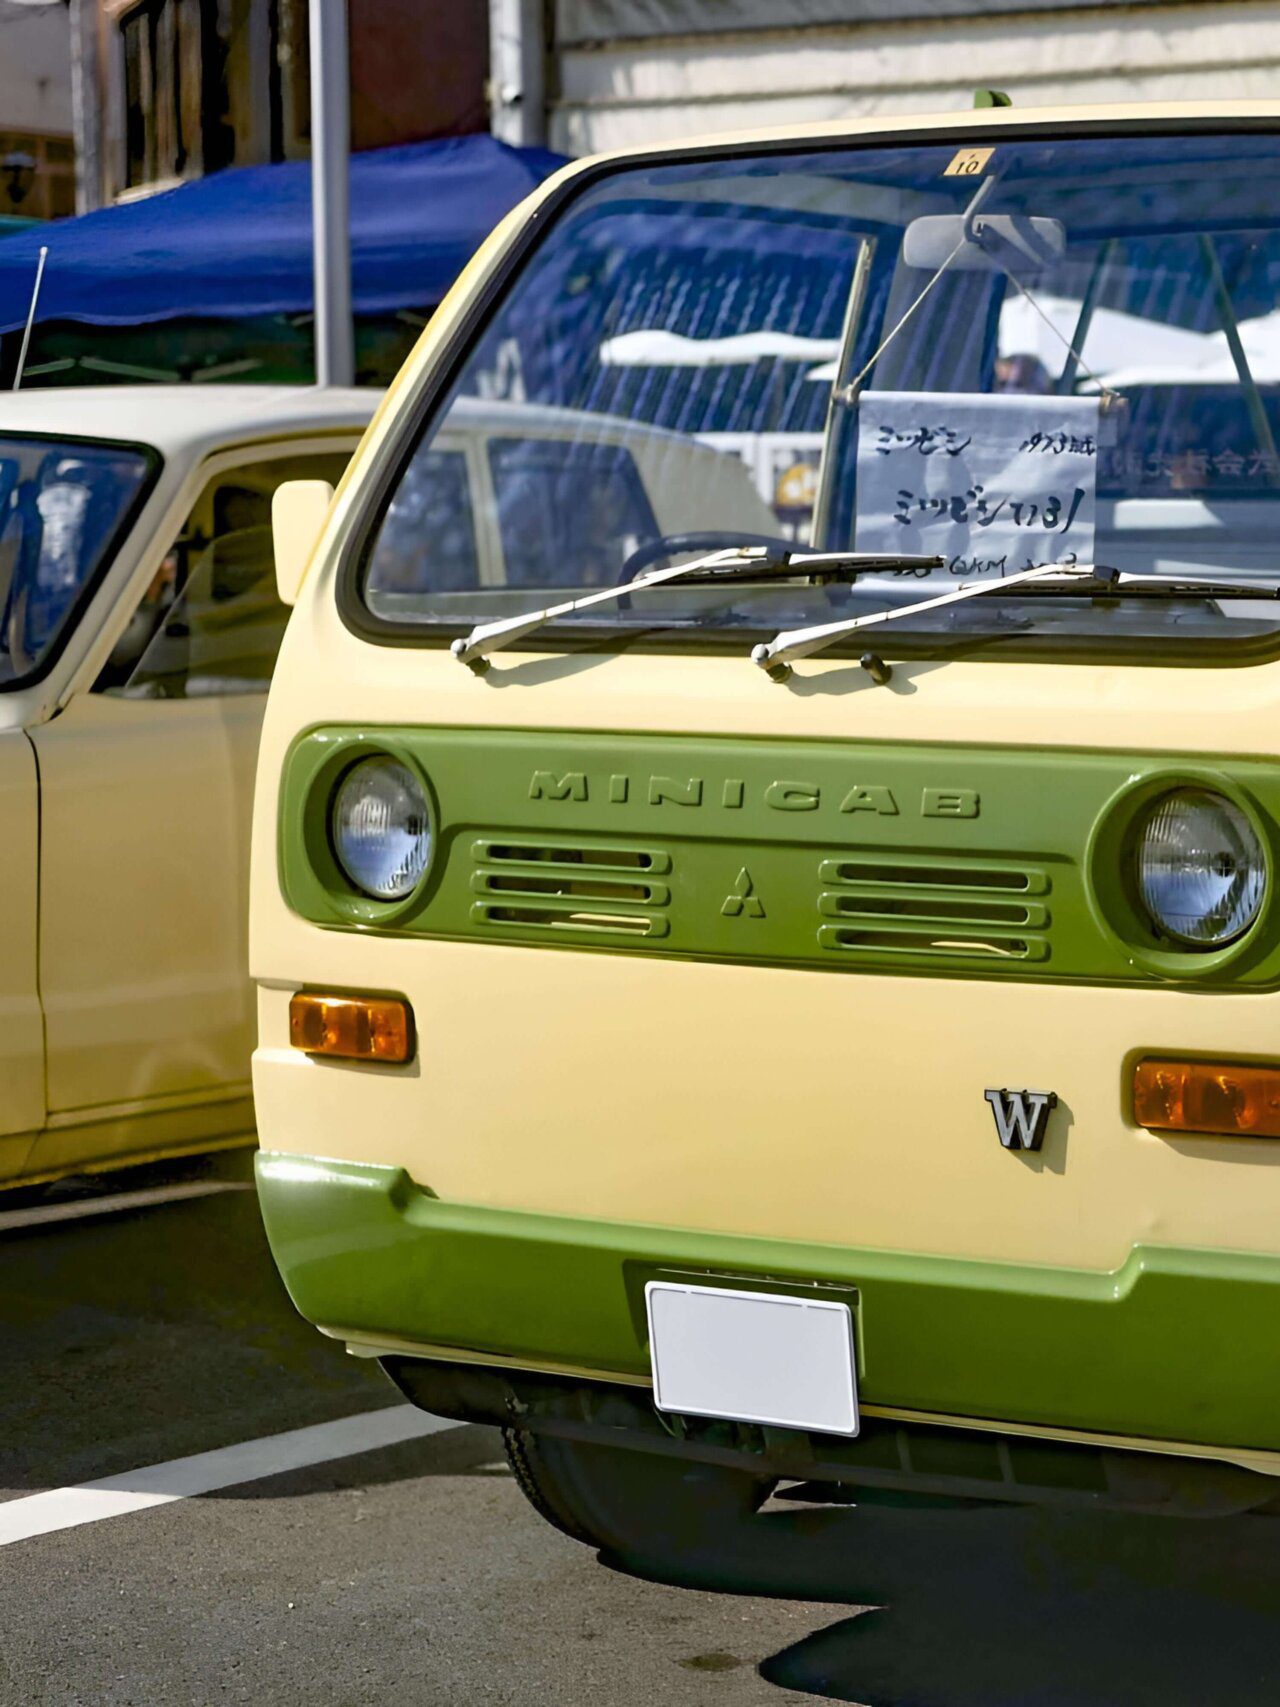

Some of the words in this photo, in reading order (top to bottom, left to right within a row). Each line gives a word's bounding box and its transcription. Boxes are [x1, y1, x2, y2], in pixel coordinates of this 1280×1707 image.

[956, 160, 979, 175] 10
[529, 770, 981, 819] MINICAB
[984, 1088, 1058, 1152] W
